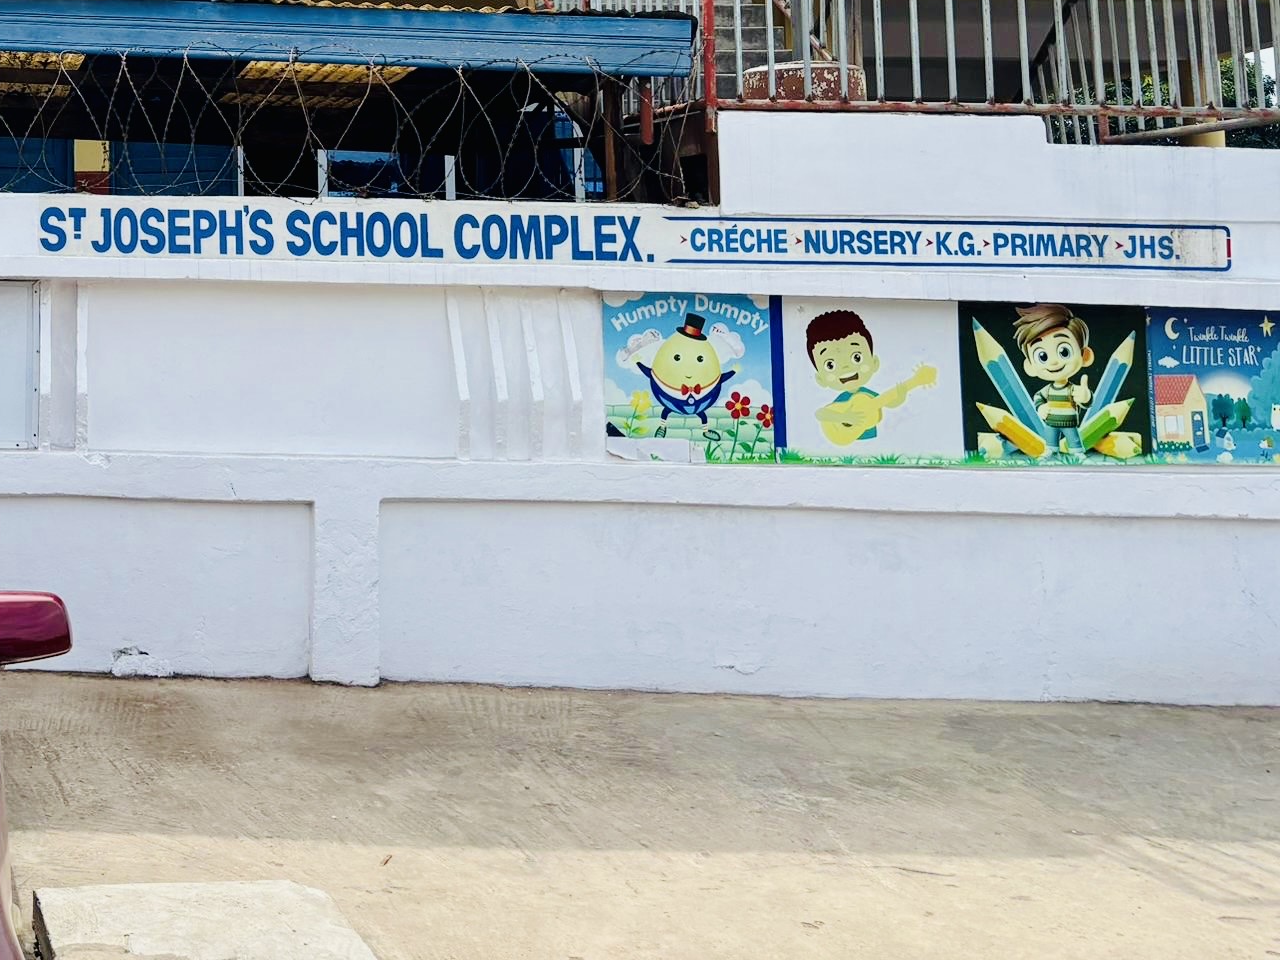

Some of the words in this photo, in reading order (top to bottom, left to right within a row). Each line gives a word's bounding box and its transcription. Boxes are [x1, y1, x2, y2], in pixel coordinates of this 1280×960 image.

[90, 204, 275, 256] JOSEPH'S
[286, 209, 446, 259] SCHOOL
[453, 214, 655, 263] COMPLEX.
[689, 224, 788, 254] CRÉCHE
[803, 228, 922, 256] NURSERY
[934, 230, 983, 258] K.G.
[991, 231, 1109, 258] PRIMARY
[1123, 234, 1181, 261] JHS.
[610, 295, 688, 332] Humpty
[694, 294, 769, 336] Dumpty
[1182, 344, 1225, 366] LITTLE
[1228, 344, 1259, 367] STAR
